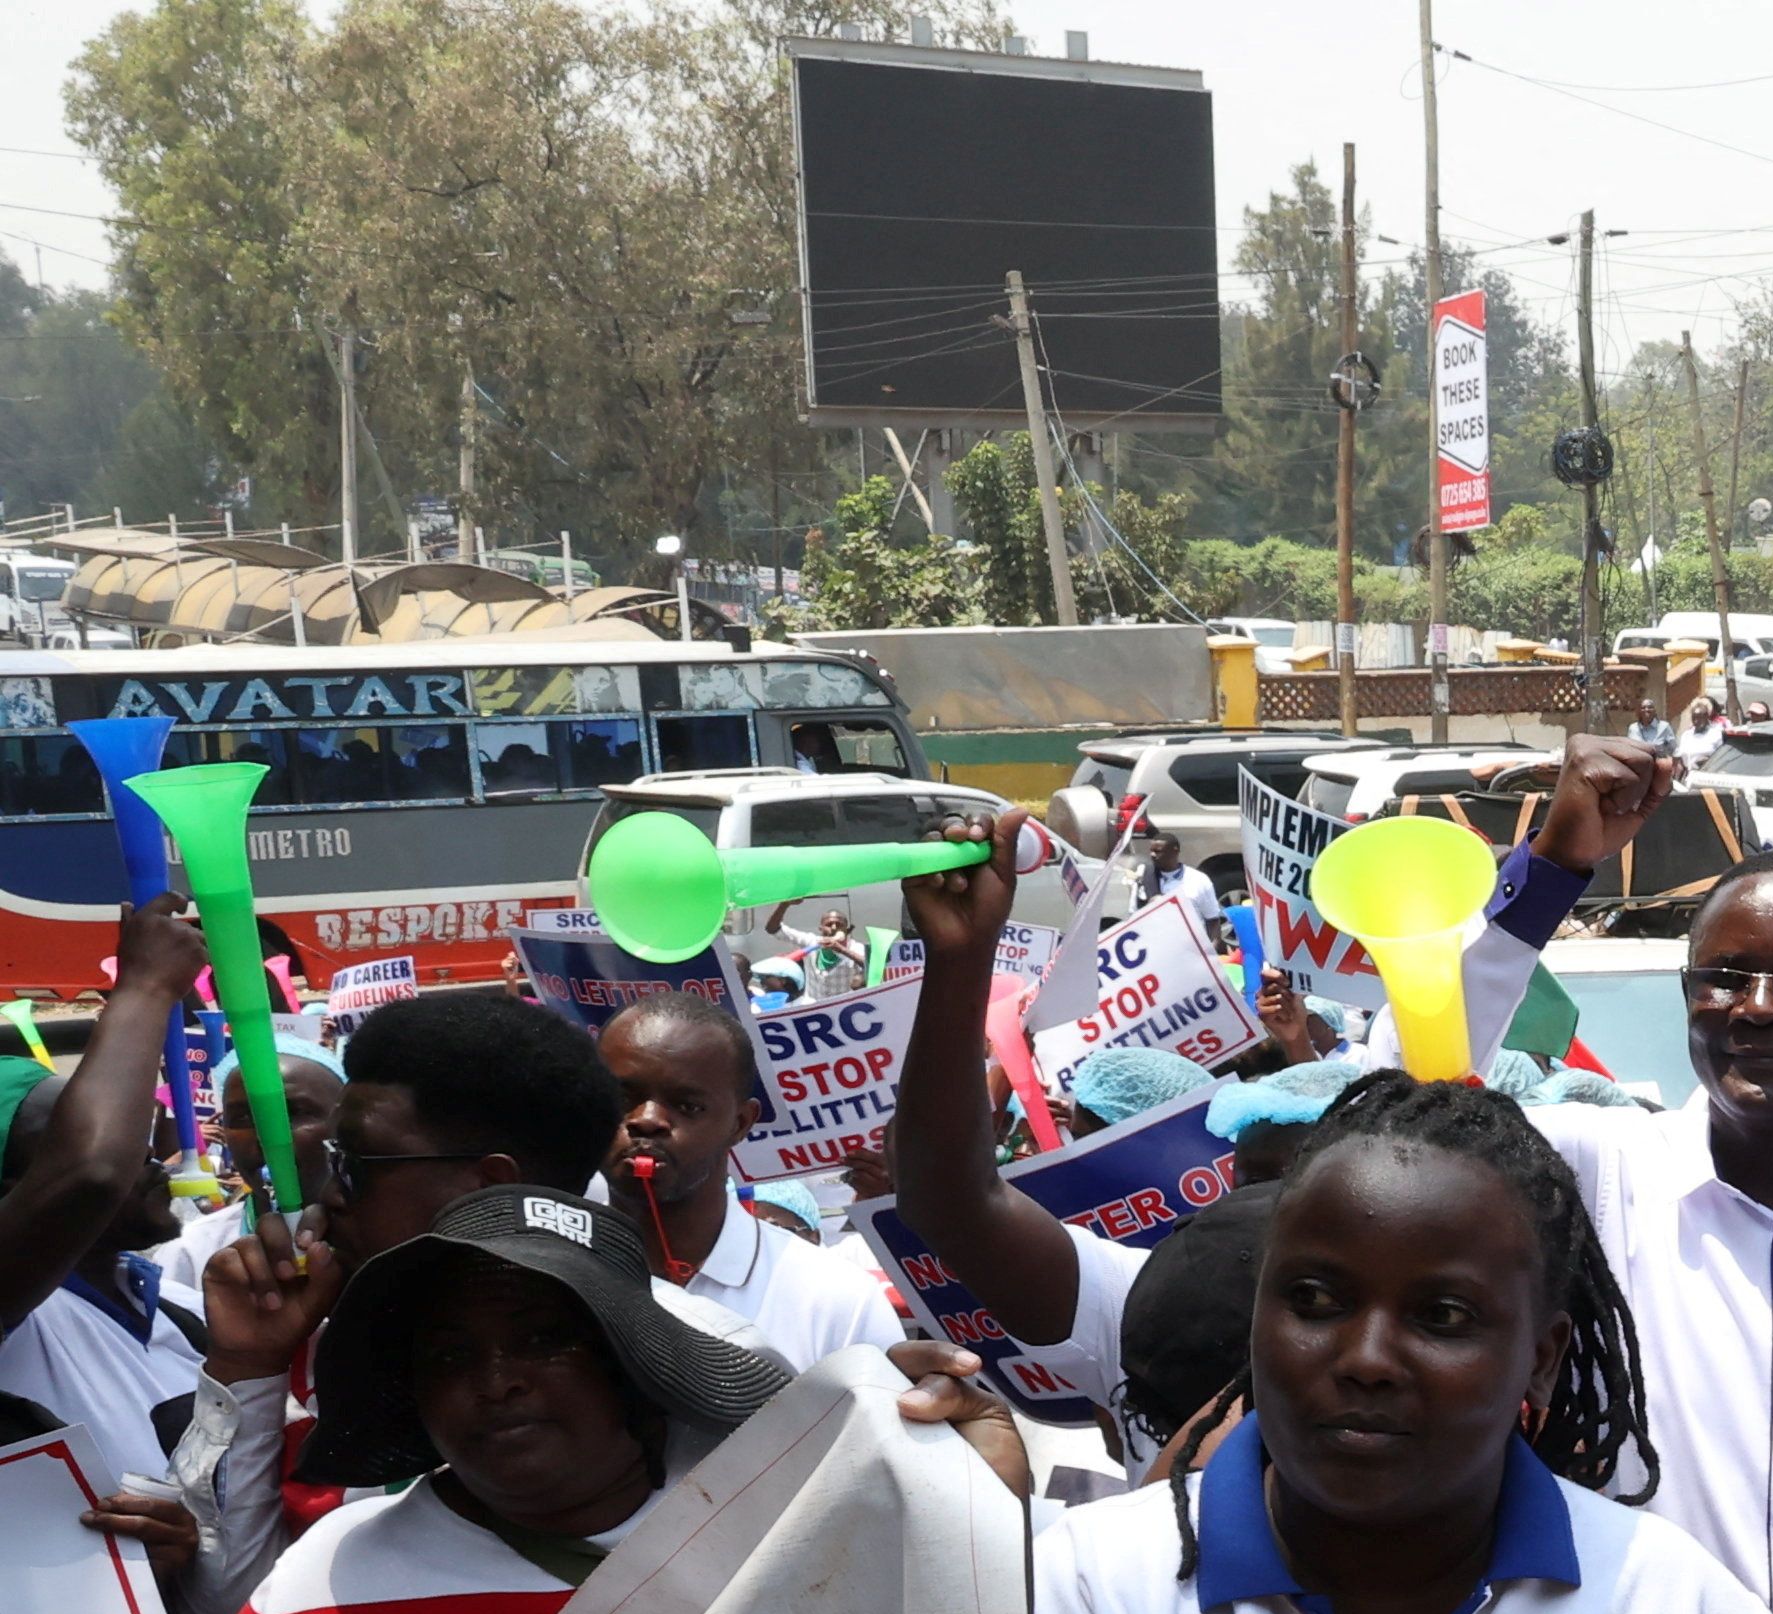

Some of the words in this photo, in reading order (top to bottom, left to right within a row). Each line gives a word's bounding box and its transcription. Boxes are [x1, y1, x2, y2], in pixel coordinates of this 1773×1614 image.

[1443, 340, 1477, 370] BOOK
[1442, 377, 1480, 407] THESE
[1440, 414, 1484, 445] SPACES
[107, 673, 475, 723] AVATAR
[249, 827, 352, 860] METRO
[1258, 843, 1284, 889] THE
[315, 901, 523, 951] BESPOKE
[556, 913, 601, 928] SRC
[332, 972, 349, 992] NO
[353, 959, 411, 985] CAREER
[329, 983, 416, 1012] GUIDELINES
[1077, 973, 1160, 1043] STOP
[758, 1001, 884, 1061] SRC
[776, 1047, 894, 1103] STOP
